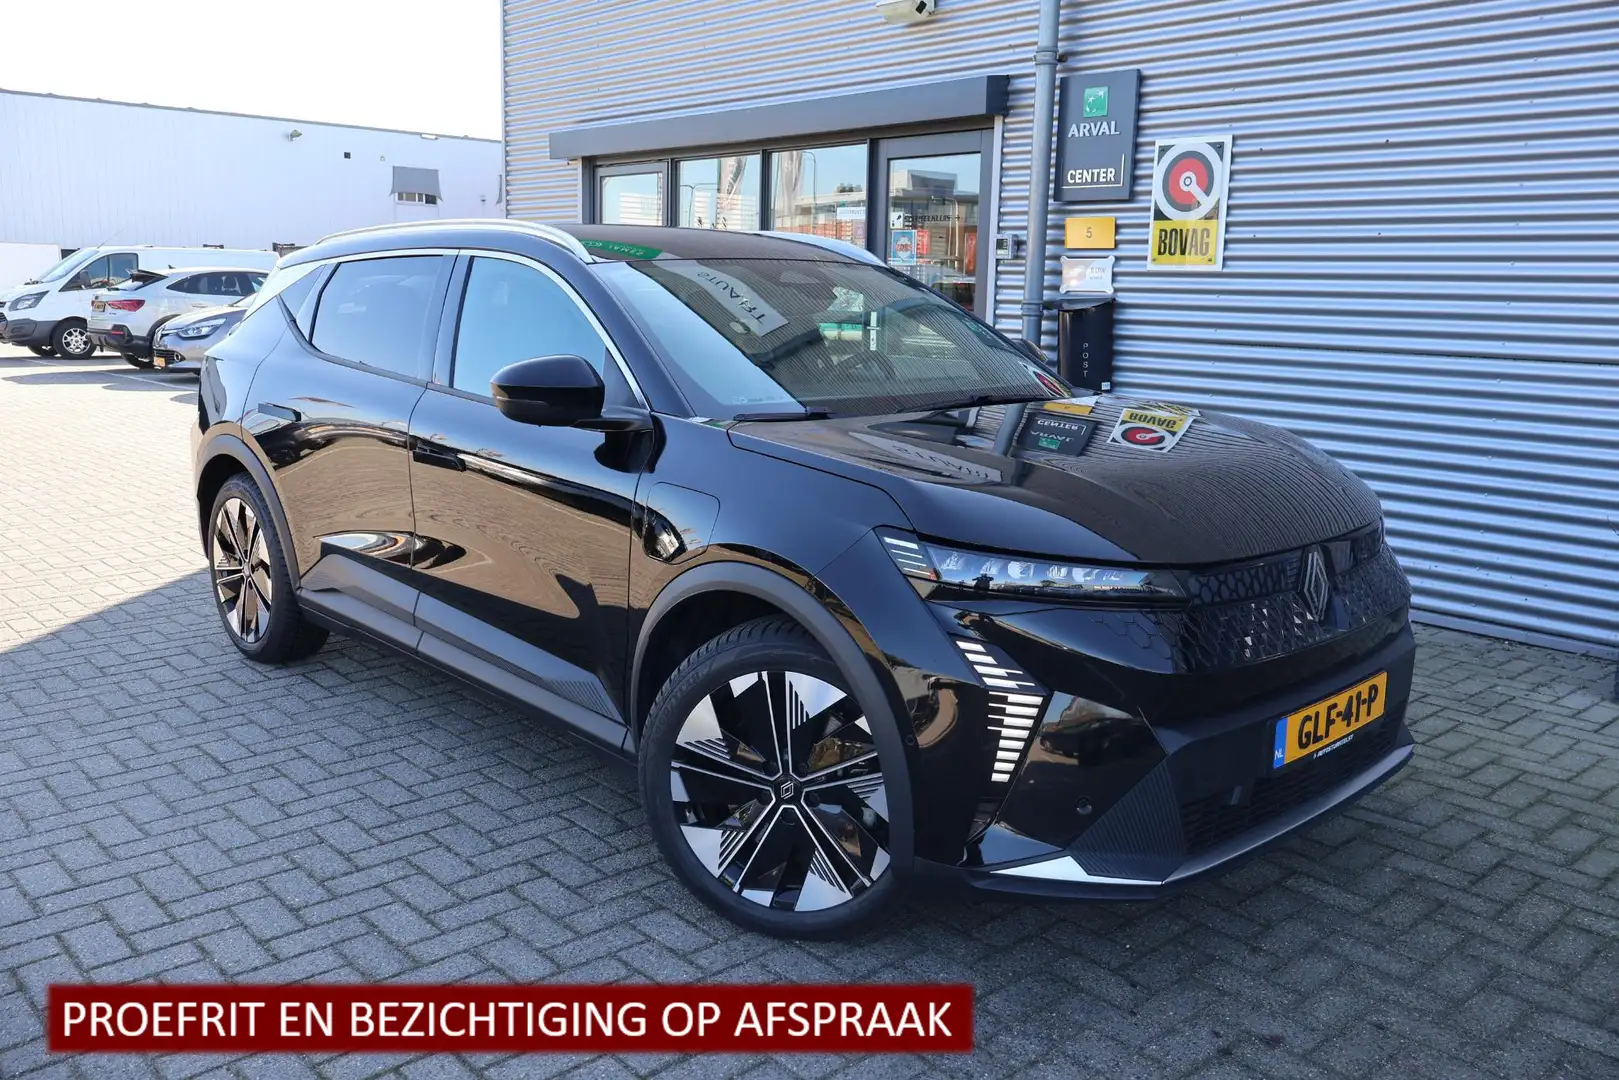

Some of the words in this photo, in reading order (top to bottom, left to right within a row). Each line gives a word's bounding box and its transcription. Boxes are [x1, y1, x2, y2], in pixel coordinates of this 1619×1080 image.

[1067, 120, 1120, 138] ARVAL
[1067, 167, 1116, 184] CENTER
[1085, 226, 1093, 239] 5
[1157, 227, 1211, 257] BOVAG
[1297, 683, 1379, 750] GLF-41-P
[1274, 747, 1284, 761] NL
